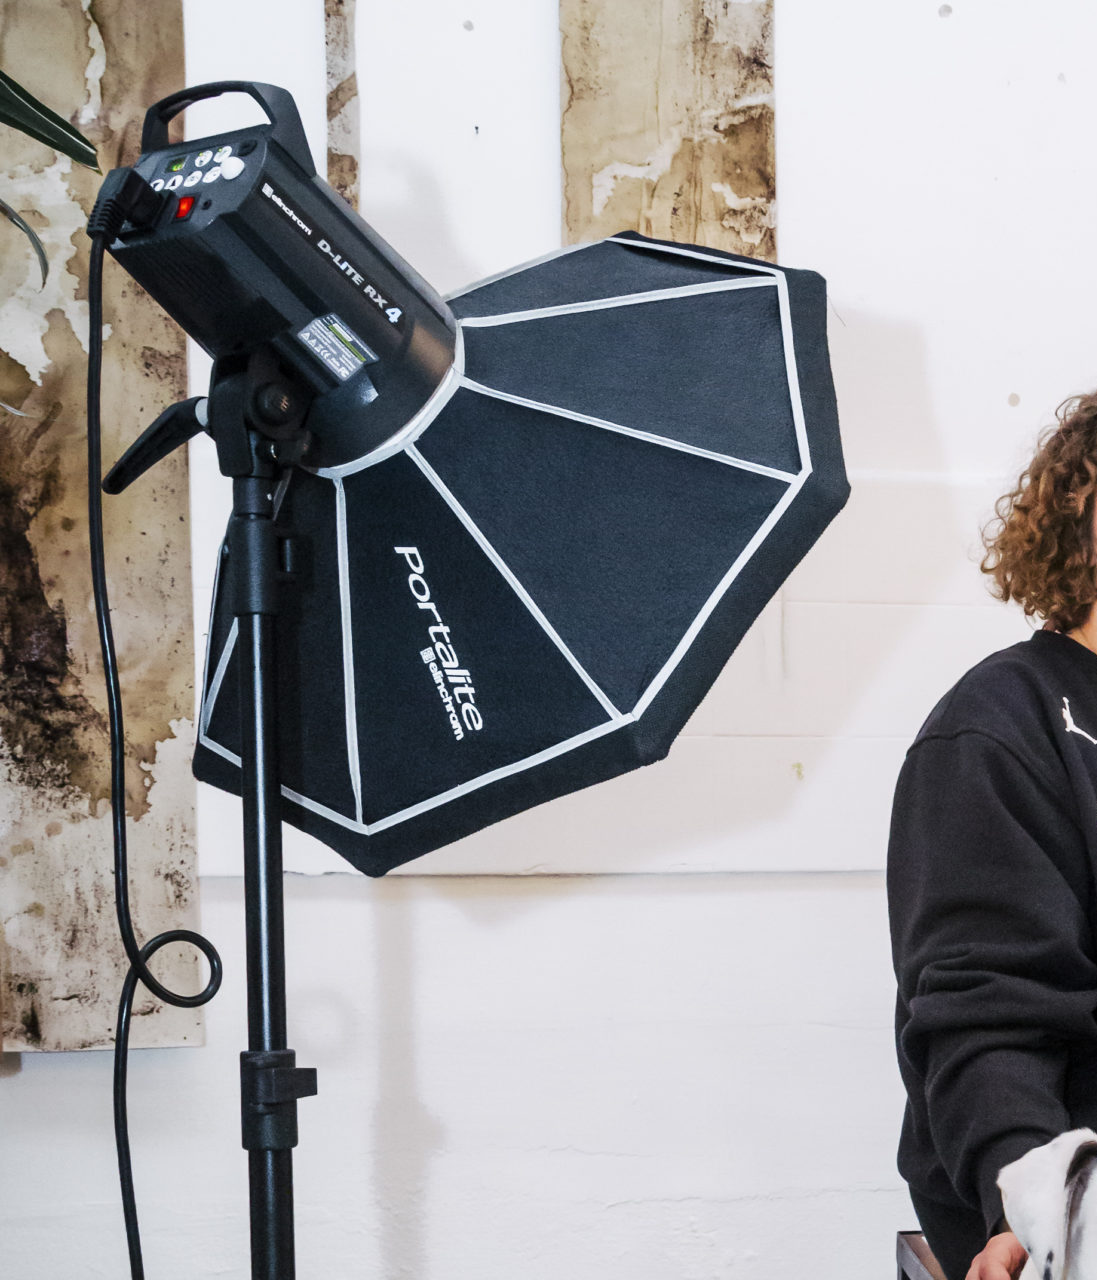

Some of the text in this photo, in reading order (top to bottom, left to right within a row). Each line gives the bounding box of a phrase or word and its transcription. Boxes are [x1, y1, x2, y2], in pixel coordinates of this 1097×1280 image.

[272, 194, 402, 323] elinchrom D-LITE RX 4
[429, 662, 464, 741] elinchrom
